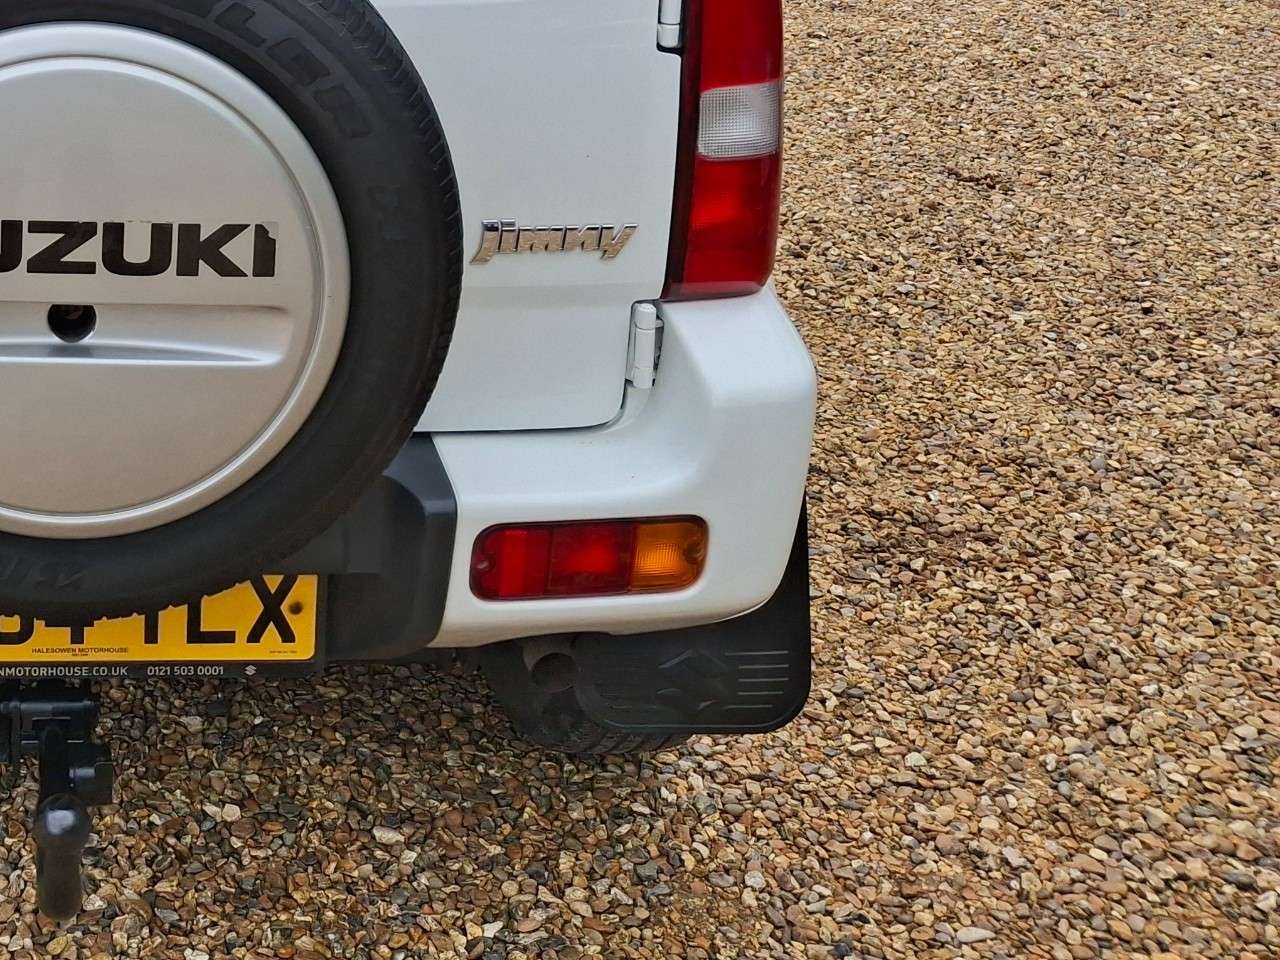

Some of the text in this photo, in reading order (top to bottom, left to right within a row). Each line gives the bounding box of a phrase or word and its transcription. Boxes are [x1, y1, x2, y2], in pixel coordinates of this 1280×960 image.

[147, 665, 171, 676] 0121
[174, 665, 194, 676] 503
[197, 665, 224, 676] 0001
